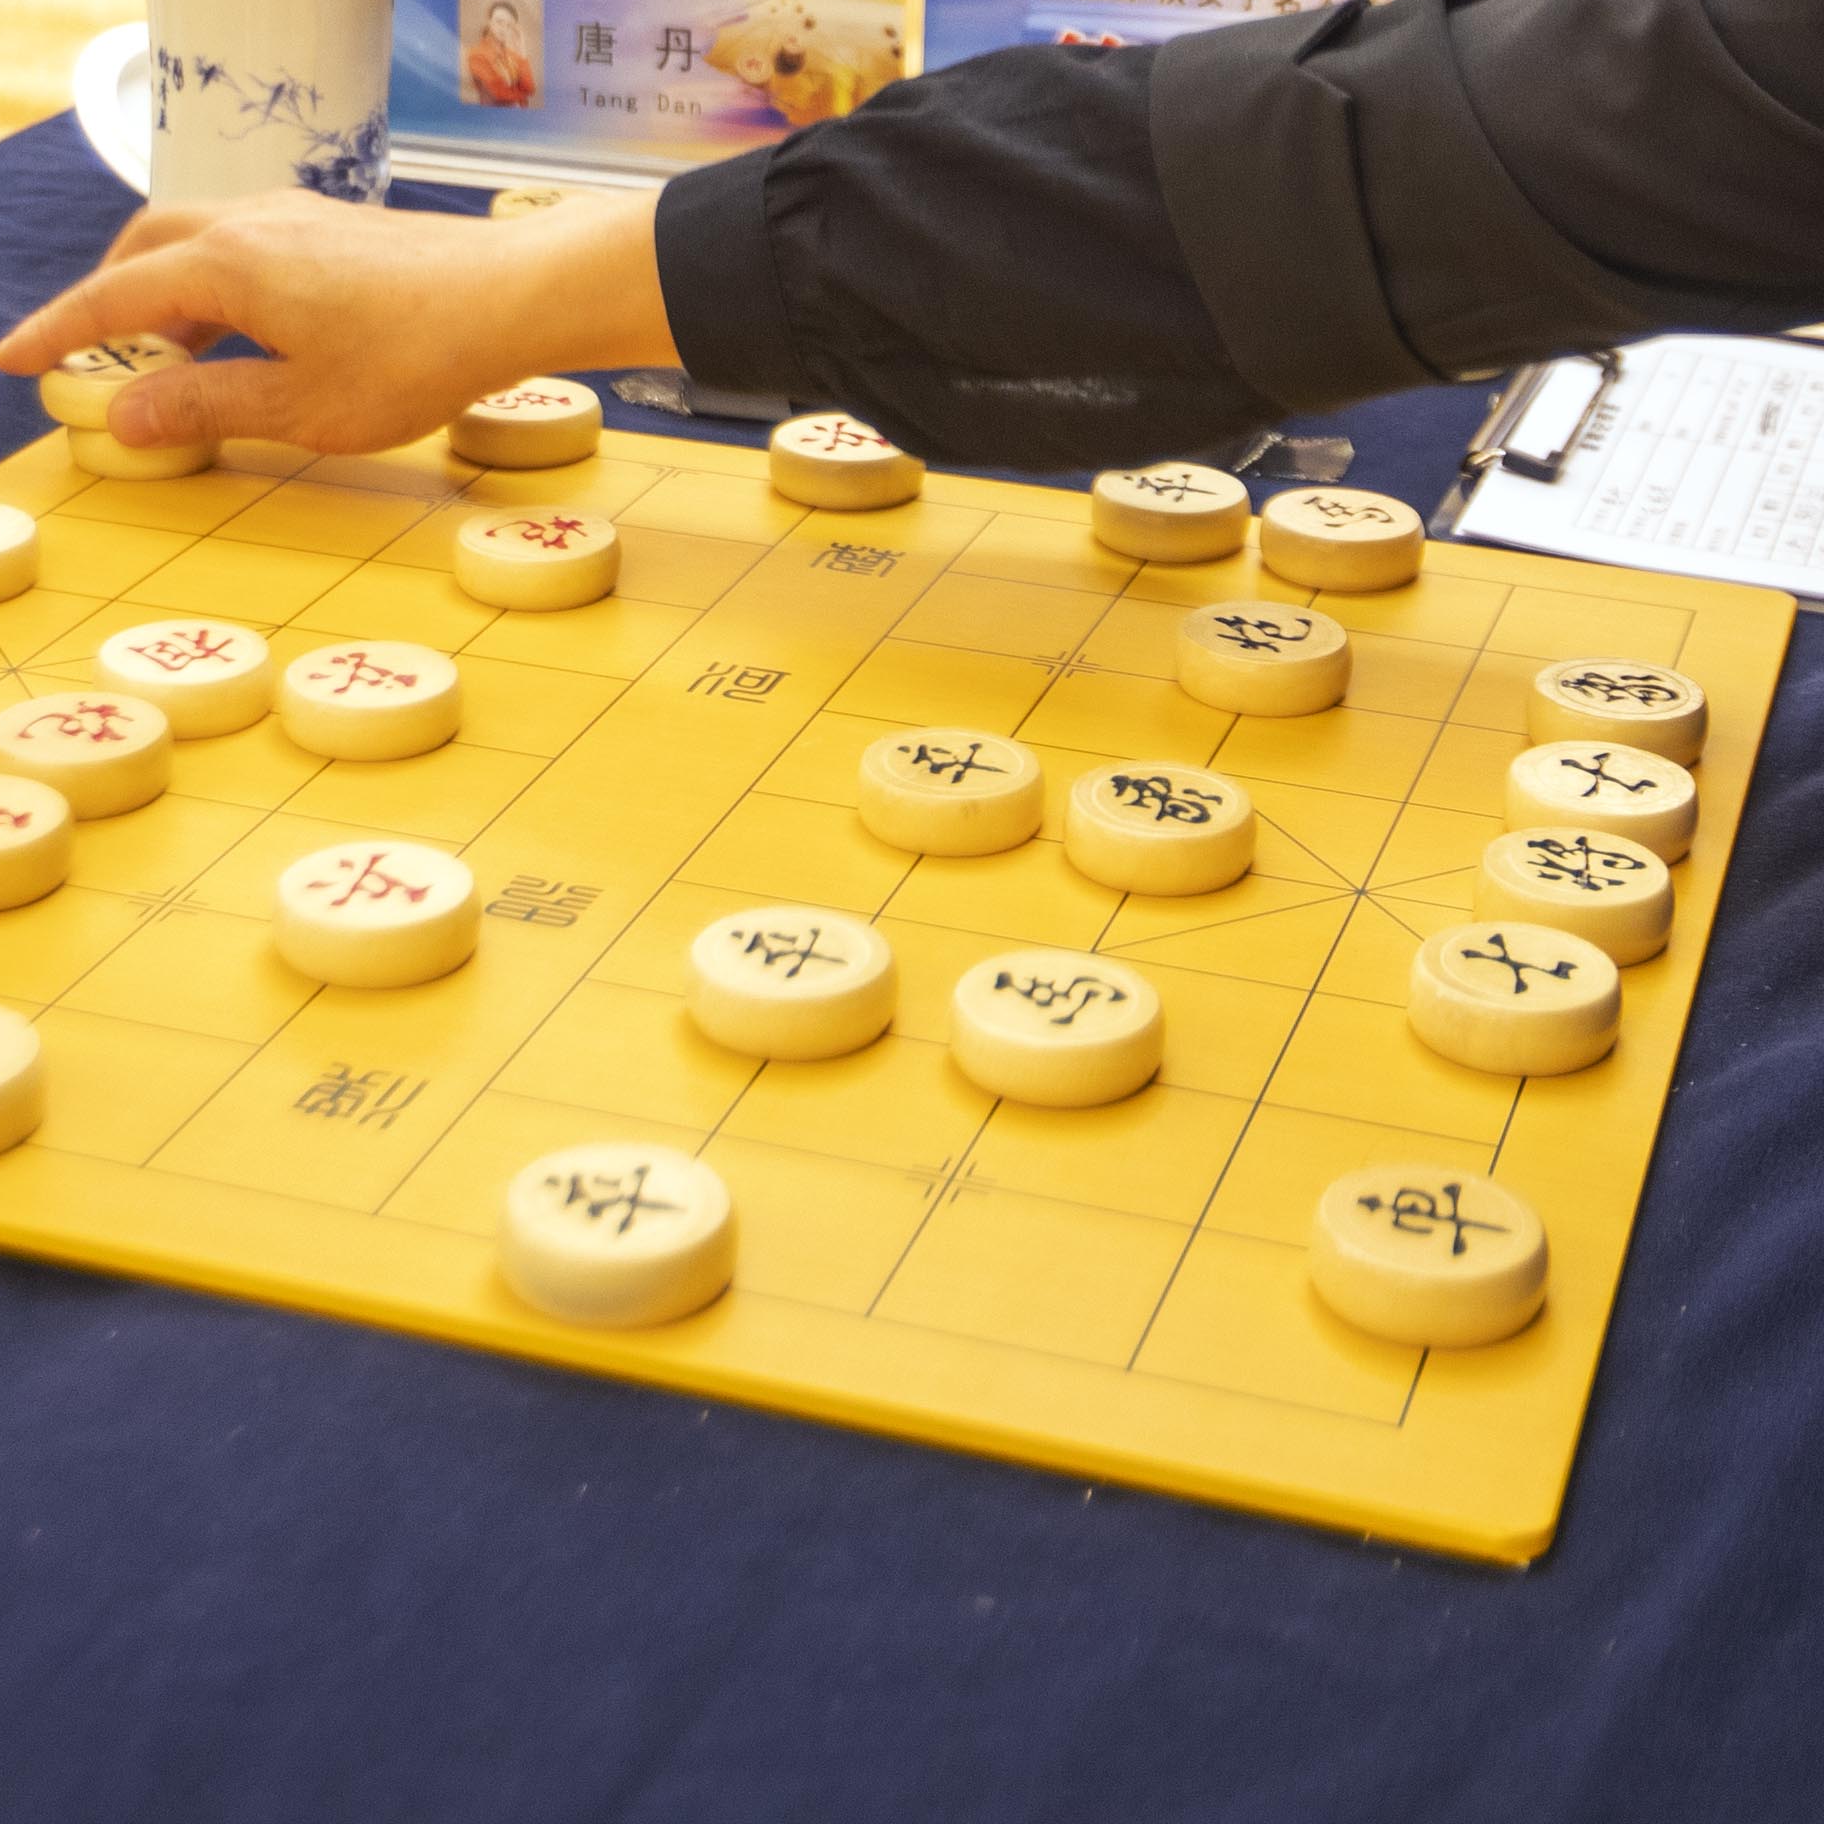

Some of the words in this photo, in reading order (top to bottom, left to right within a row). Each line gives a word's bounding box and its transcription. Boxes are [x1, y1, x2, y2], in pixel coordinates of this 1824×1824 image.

[580, 87, 638, 114] Tang
[657, 92, 702, 116] Dan
[1124, 473, 1219, 504] 卒
[309, 652, 417, 695] 兵
[898, 742, 1008, 785] 卒
[308, 854, 428, 907] 兵
[732, 927, 849, 980] 卒
[541, 1162, 686, 1237] 卒
